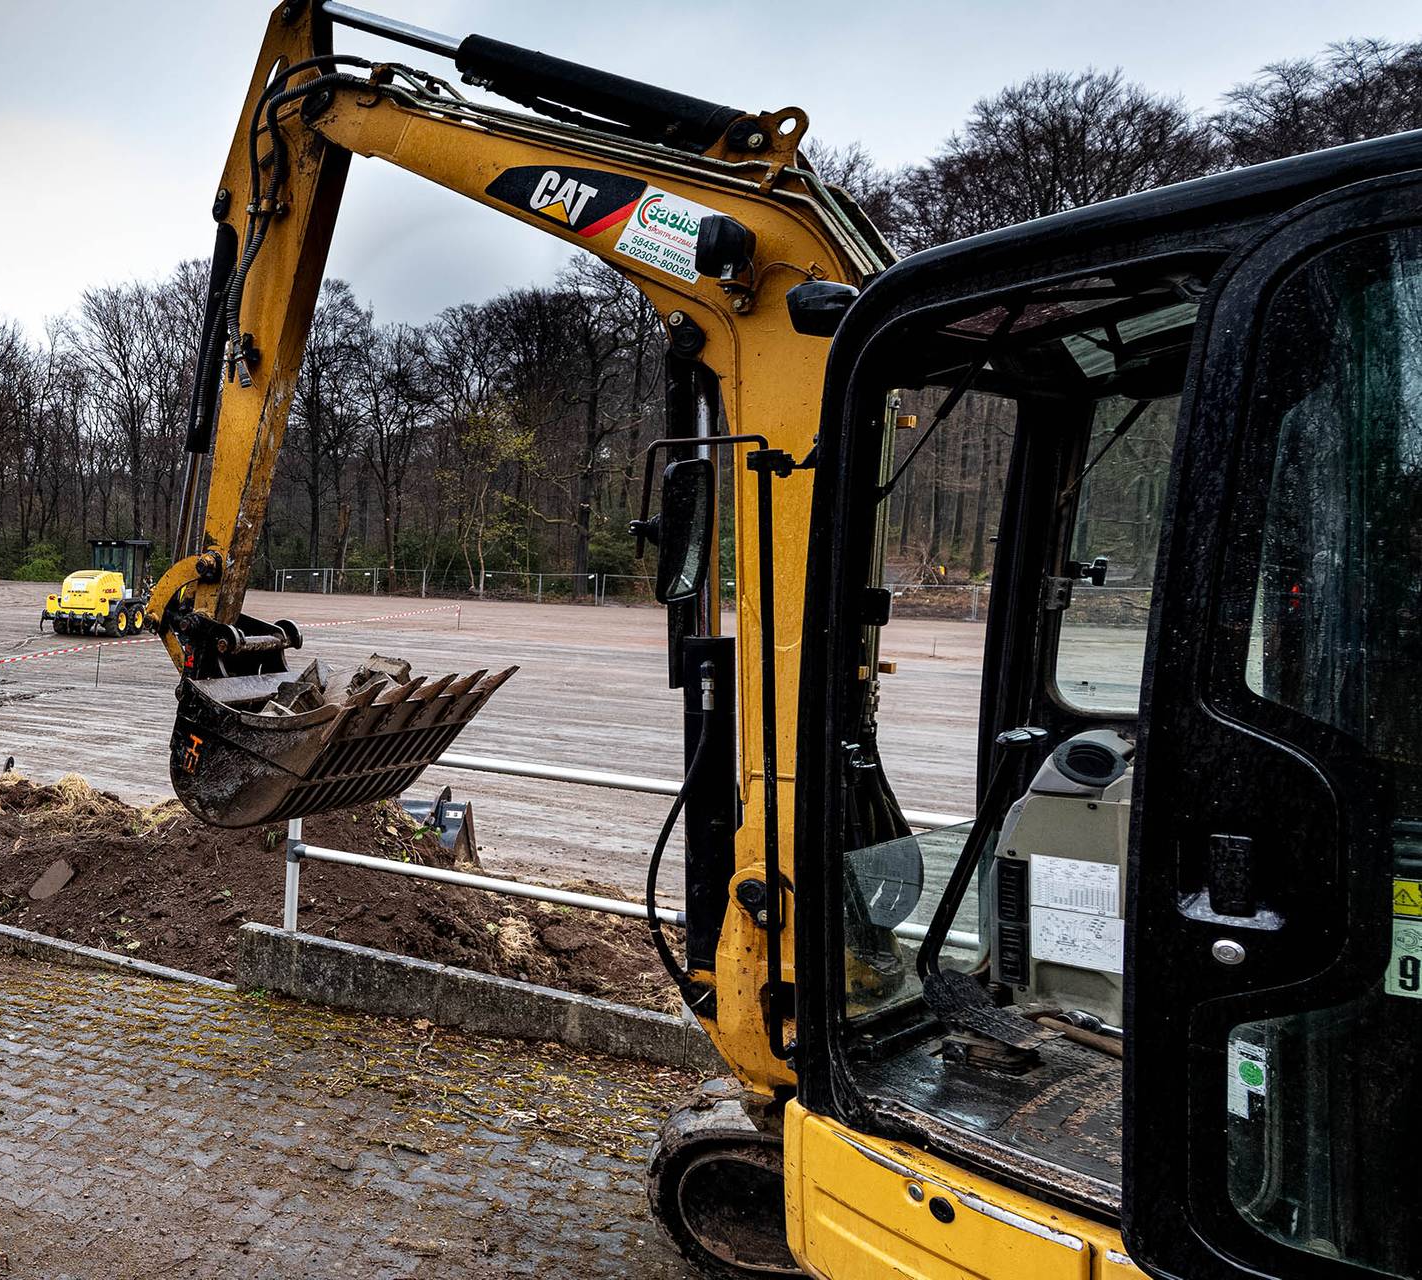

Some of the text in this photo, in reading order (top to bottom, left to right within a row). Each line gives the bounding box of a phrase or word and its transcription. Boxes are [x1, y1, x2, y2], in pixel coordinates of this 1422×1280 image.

[530, 170, 598, 226] CAT
[631, 235, 691, 267] 58454 Witten
[648, 225, 693, 248] SPORTPLATZBAU
[629, 246, 697, 280] 02302-800395
